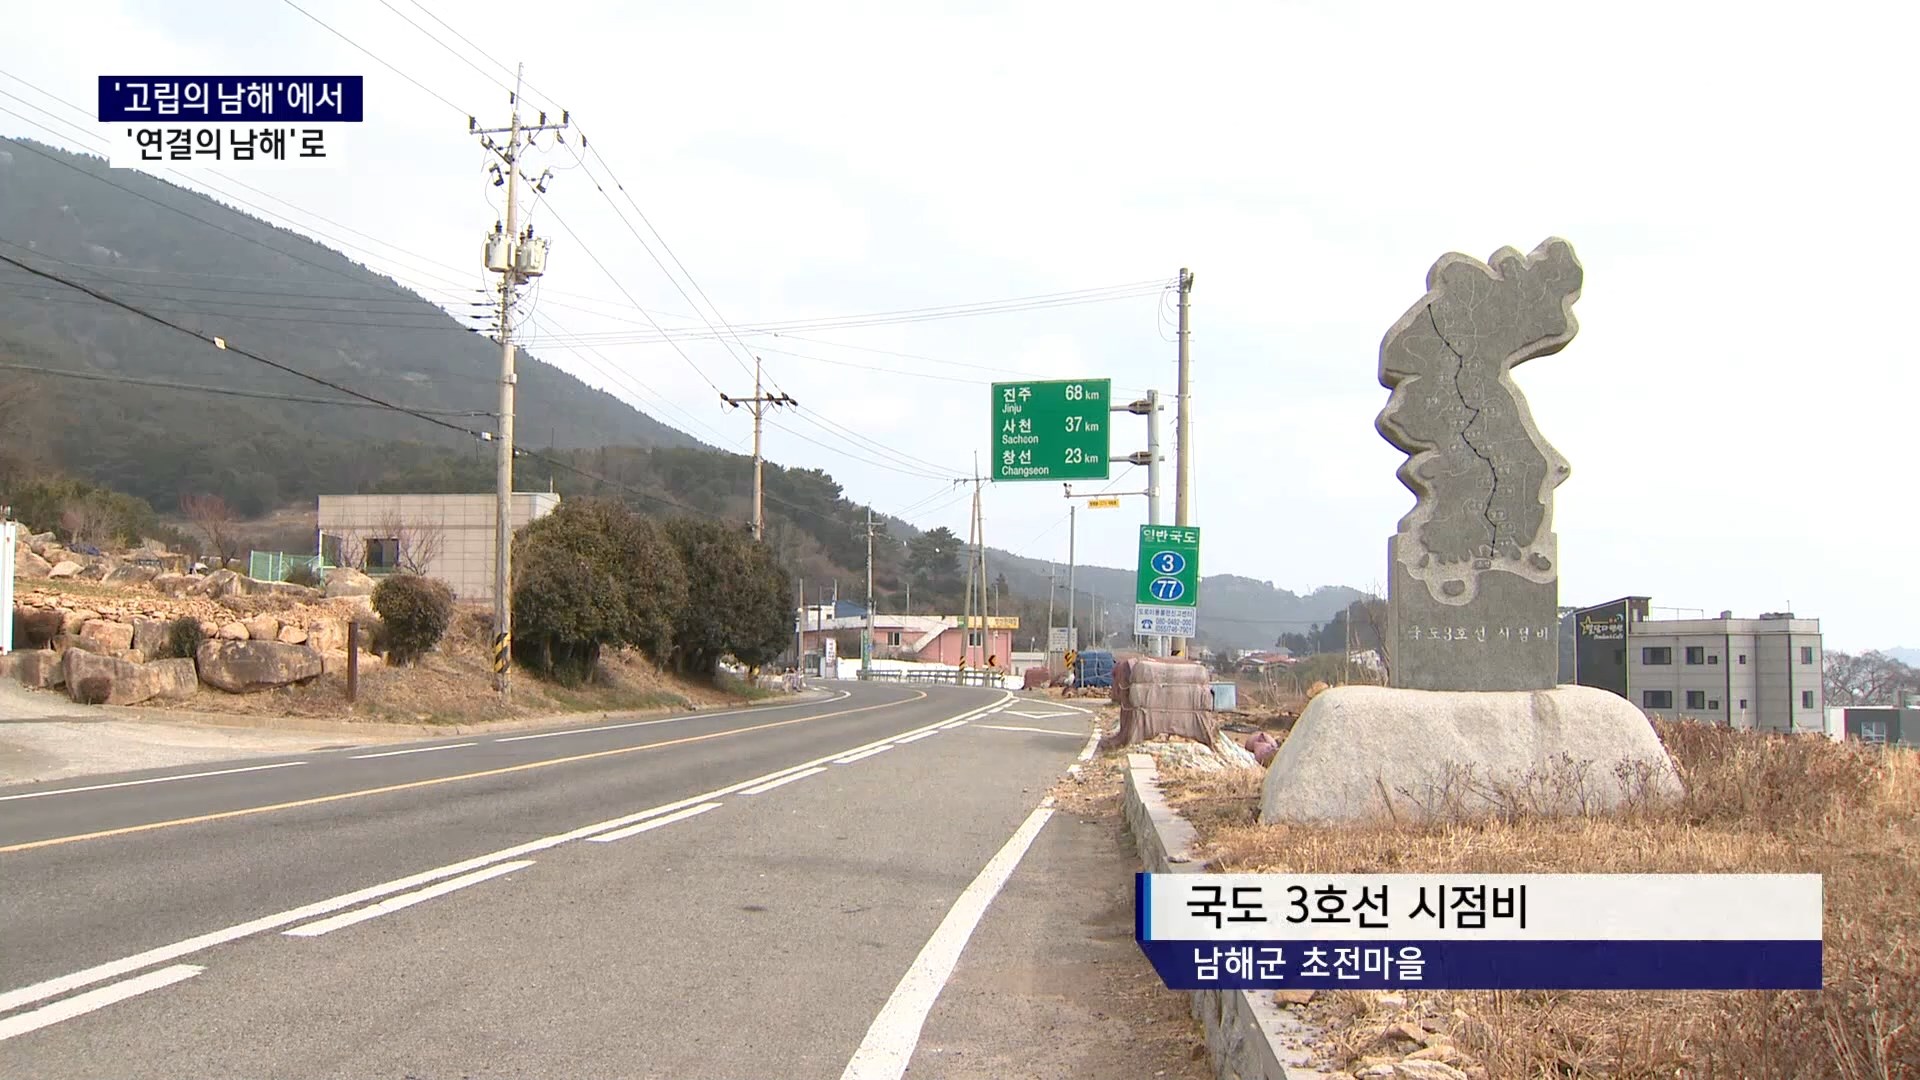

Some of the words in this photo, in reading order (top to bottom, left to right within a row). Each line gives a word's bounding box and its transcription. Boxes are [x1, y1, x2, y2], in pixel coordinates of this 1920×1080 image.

[1003, 387, 1032, 403] 진주
[1065, 384, 1083, 401] 68
[1085, 389, 1100, 401] km
[1001, 402, 1022, 415] Jinju
[1002, 418, 1032, 433] 사천
[1065, 416, 1083, 432] 37
[1084, 421, 1099, 432] km
[1002, 449, 1032, 465] 창선
[1065, 447, 1082, 464] 23
[1084, 453, 1099, 463] km
[1001, 465, 1050, 478] Changseon
[1143, 528, 1196, 544] 일반국도
[1161, 554, 1175, 572] 3
[1156, 580, 1177, 598] 77
[1499, 626, 1548, 642] 시점비
